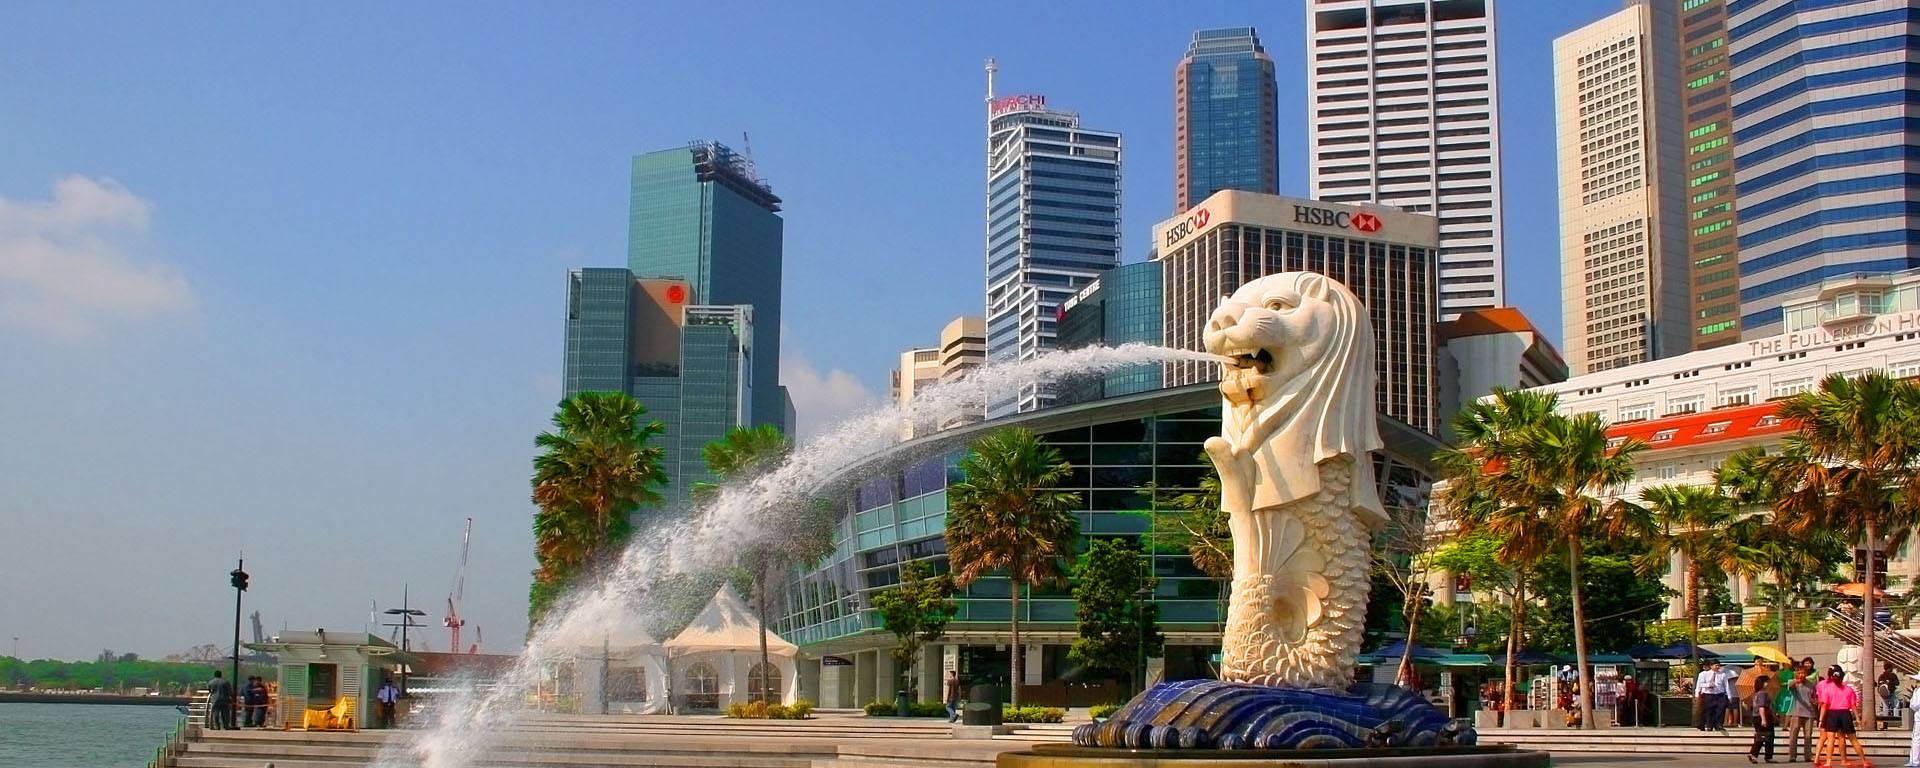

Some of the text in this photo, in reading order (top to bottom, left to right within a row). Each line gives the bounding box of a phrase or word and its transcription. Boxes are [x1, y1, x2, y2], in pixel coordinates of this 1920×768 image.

[1293, 205, 1350, 228] HSBC
[1166, 216, 1194, 248] HSBC
[1079, 279, 1101, 301] CENTRE
[1749, 313, 1920, 356] THE FULLERTON H
